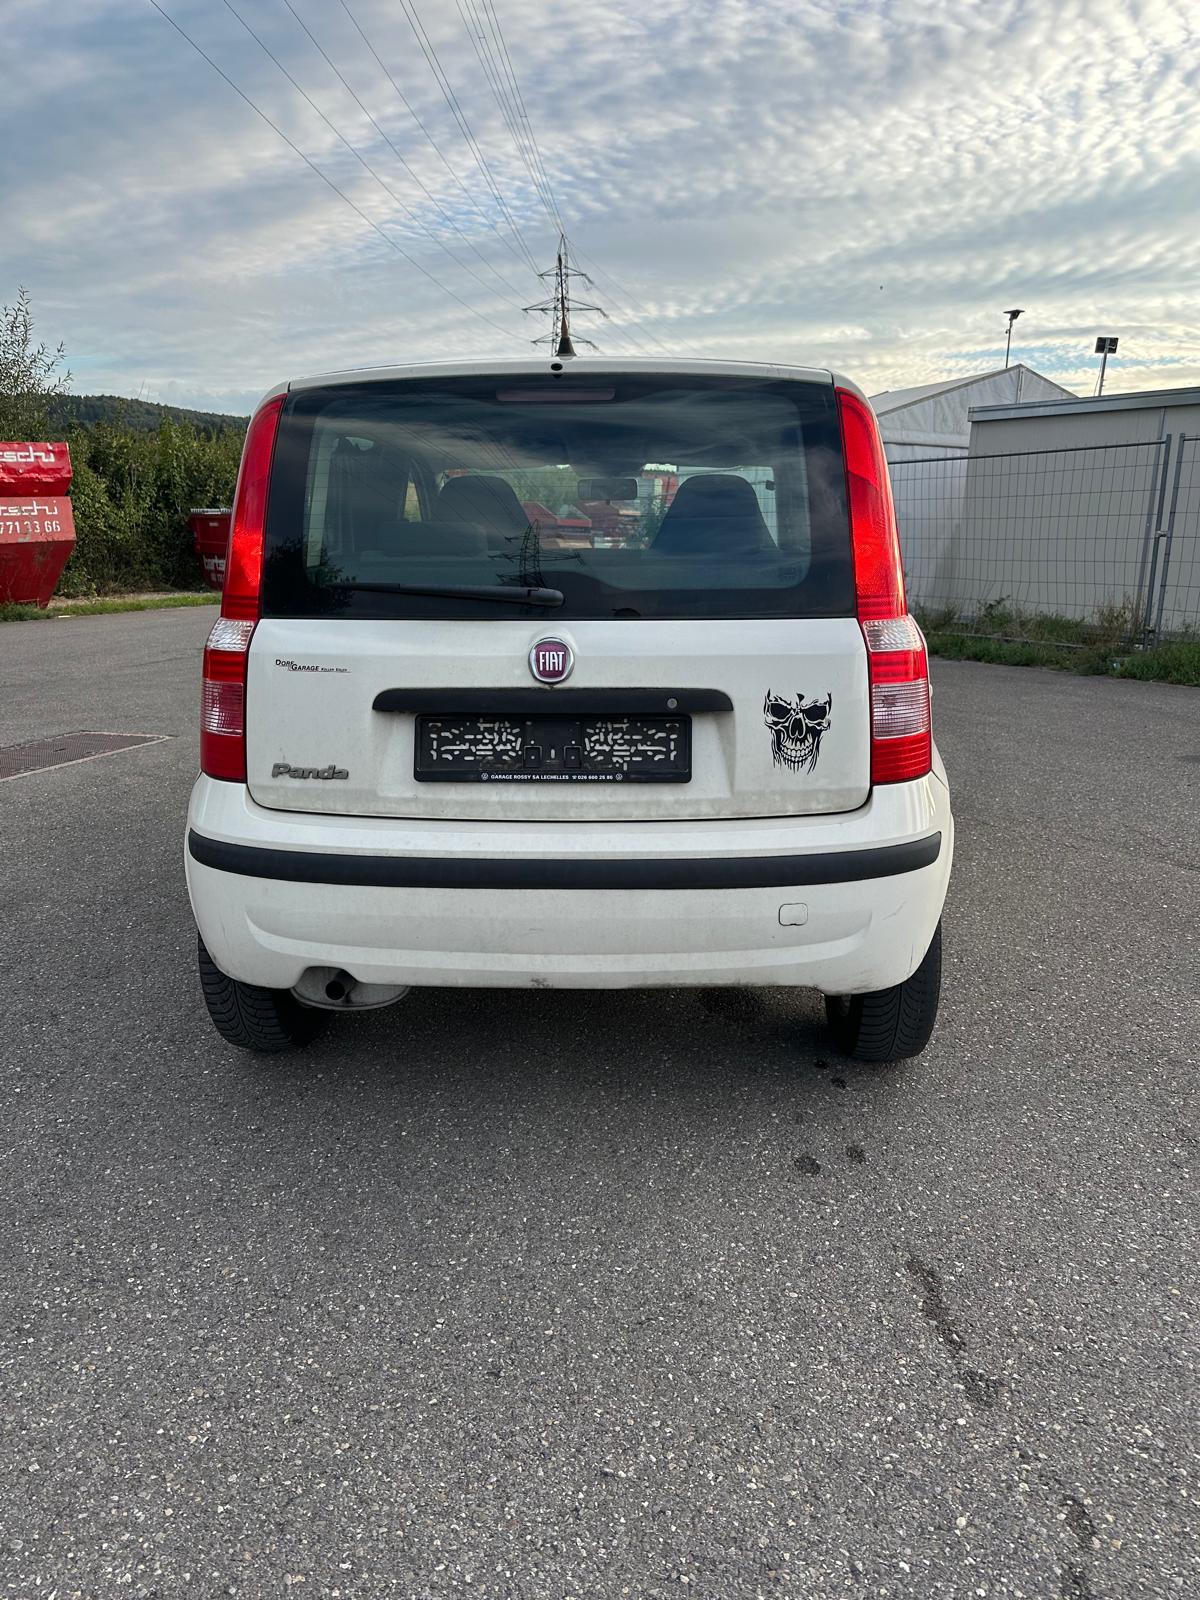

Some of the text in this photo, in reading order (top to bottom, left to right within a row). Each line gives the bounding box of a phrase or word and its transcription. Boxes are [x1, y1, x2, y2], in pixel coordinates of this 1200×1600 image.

[44, 520, 61, 533] 66
[539, 651, 565, 671] FIAT
[272, 762, 349, 780] Panda
